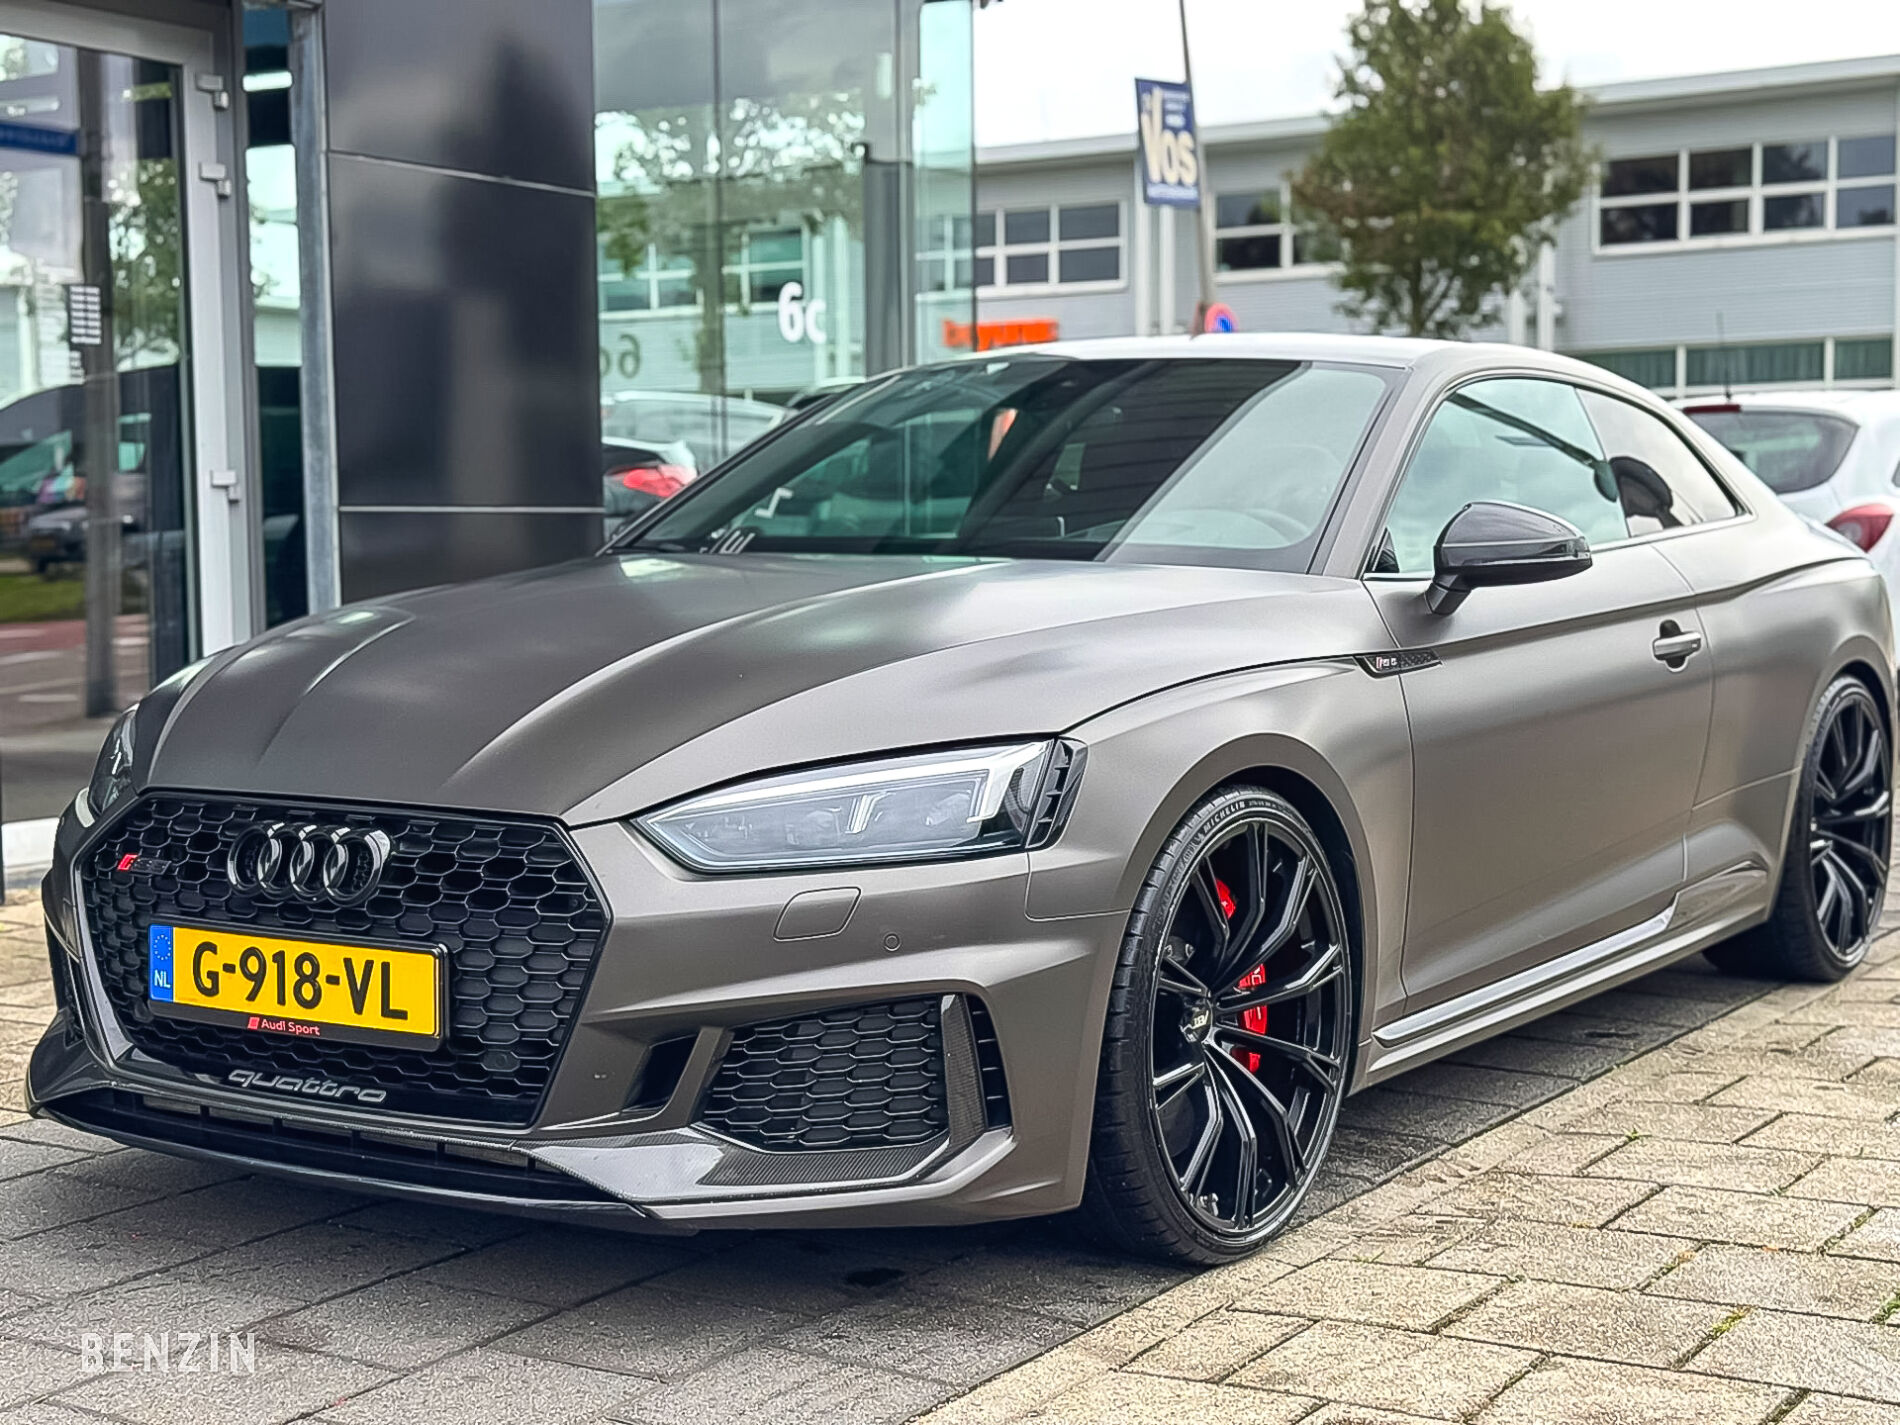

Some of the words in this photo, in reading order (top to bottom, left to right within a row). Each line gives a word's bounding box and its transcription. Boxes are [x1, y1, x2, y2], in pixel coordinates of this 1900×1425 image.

[1203, 800, 1246, 833] MICHELIN
[153, 969, 171, 988] NL
[192, 941, 409, 1021] G-918-VL
[261, 1019, 286, 1031] Audi
[288, 1021, 320, 1036] Sport
[228, 1069, 387, 1103] quattro
